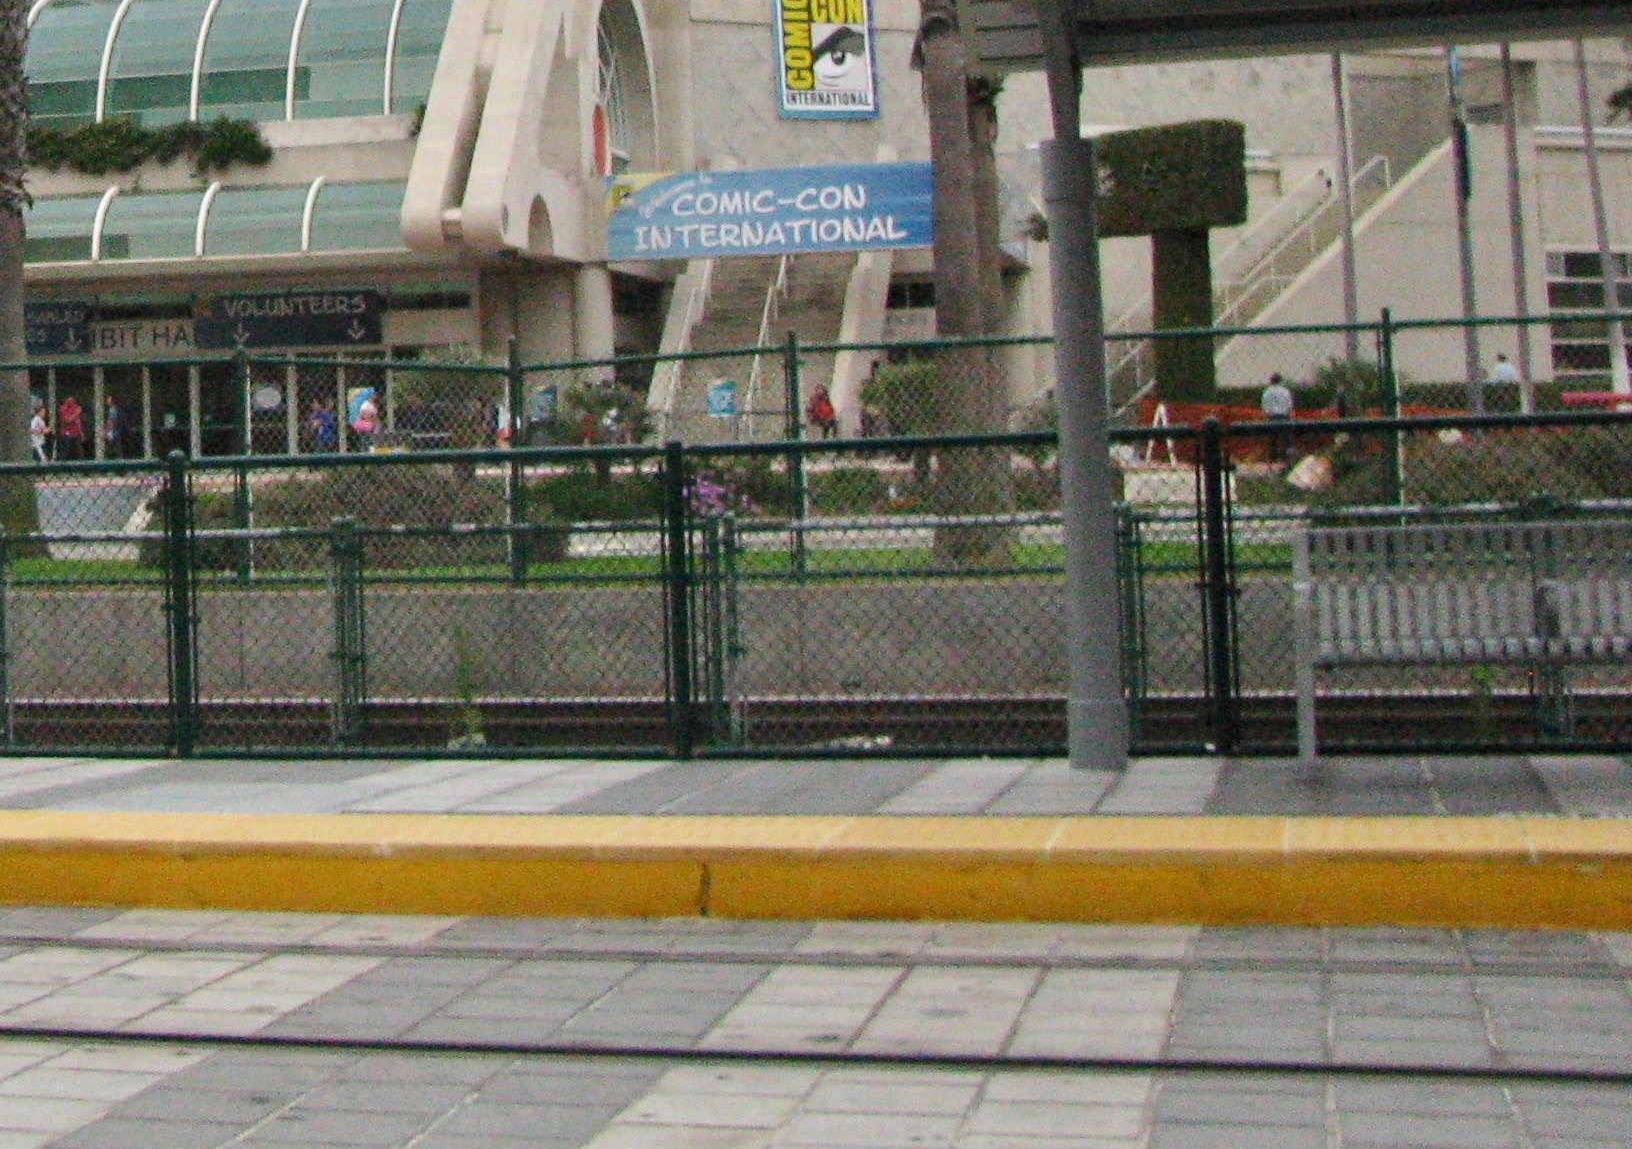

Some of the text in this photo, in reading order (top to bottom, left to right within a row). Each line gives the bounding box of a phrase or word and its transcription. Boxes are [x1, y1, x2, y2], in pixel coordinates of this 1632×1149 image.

[786, 90, 871, 107] INTERNATIONAL
[671, 184, 867, 218] COMIC-CON
[634, 215, 908, 252] INTERNATIONAL
[223, 296, 366, 318] VOLUNTEERS
